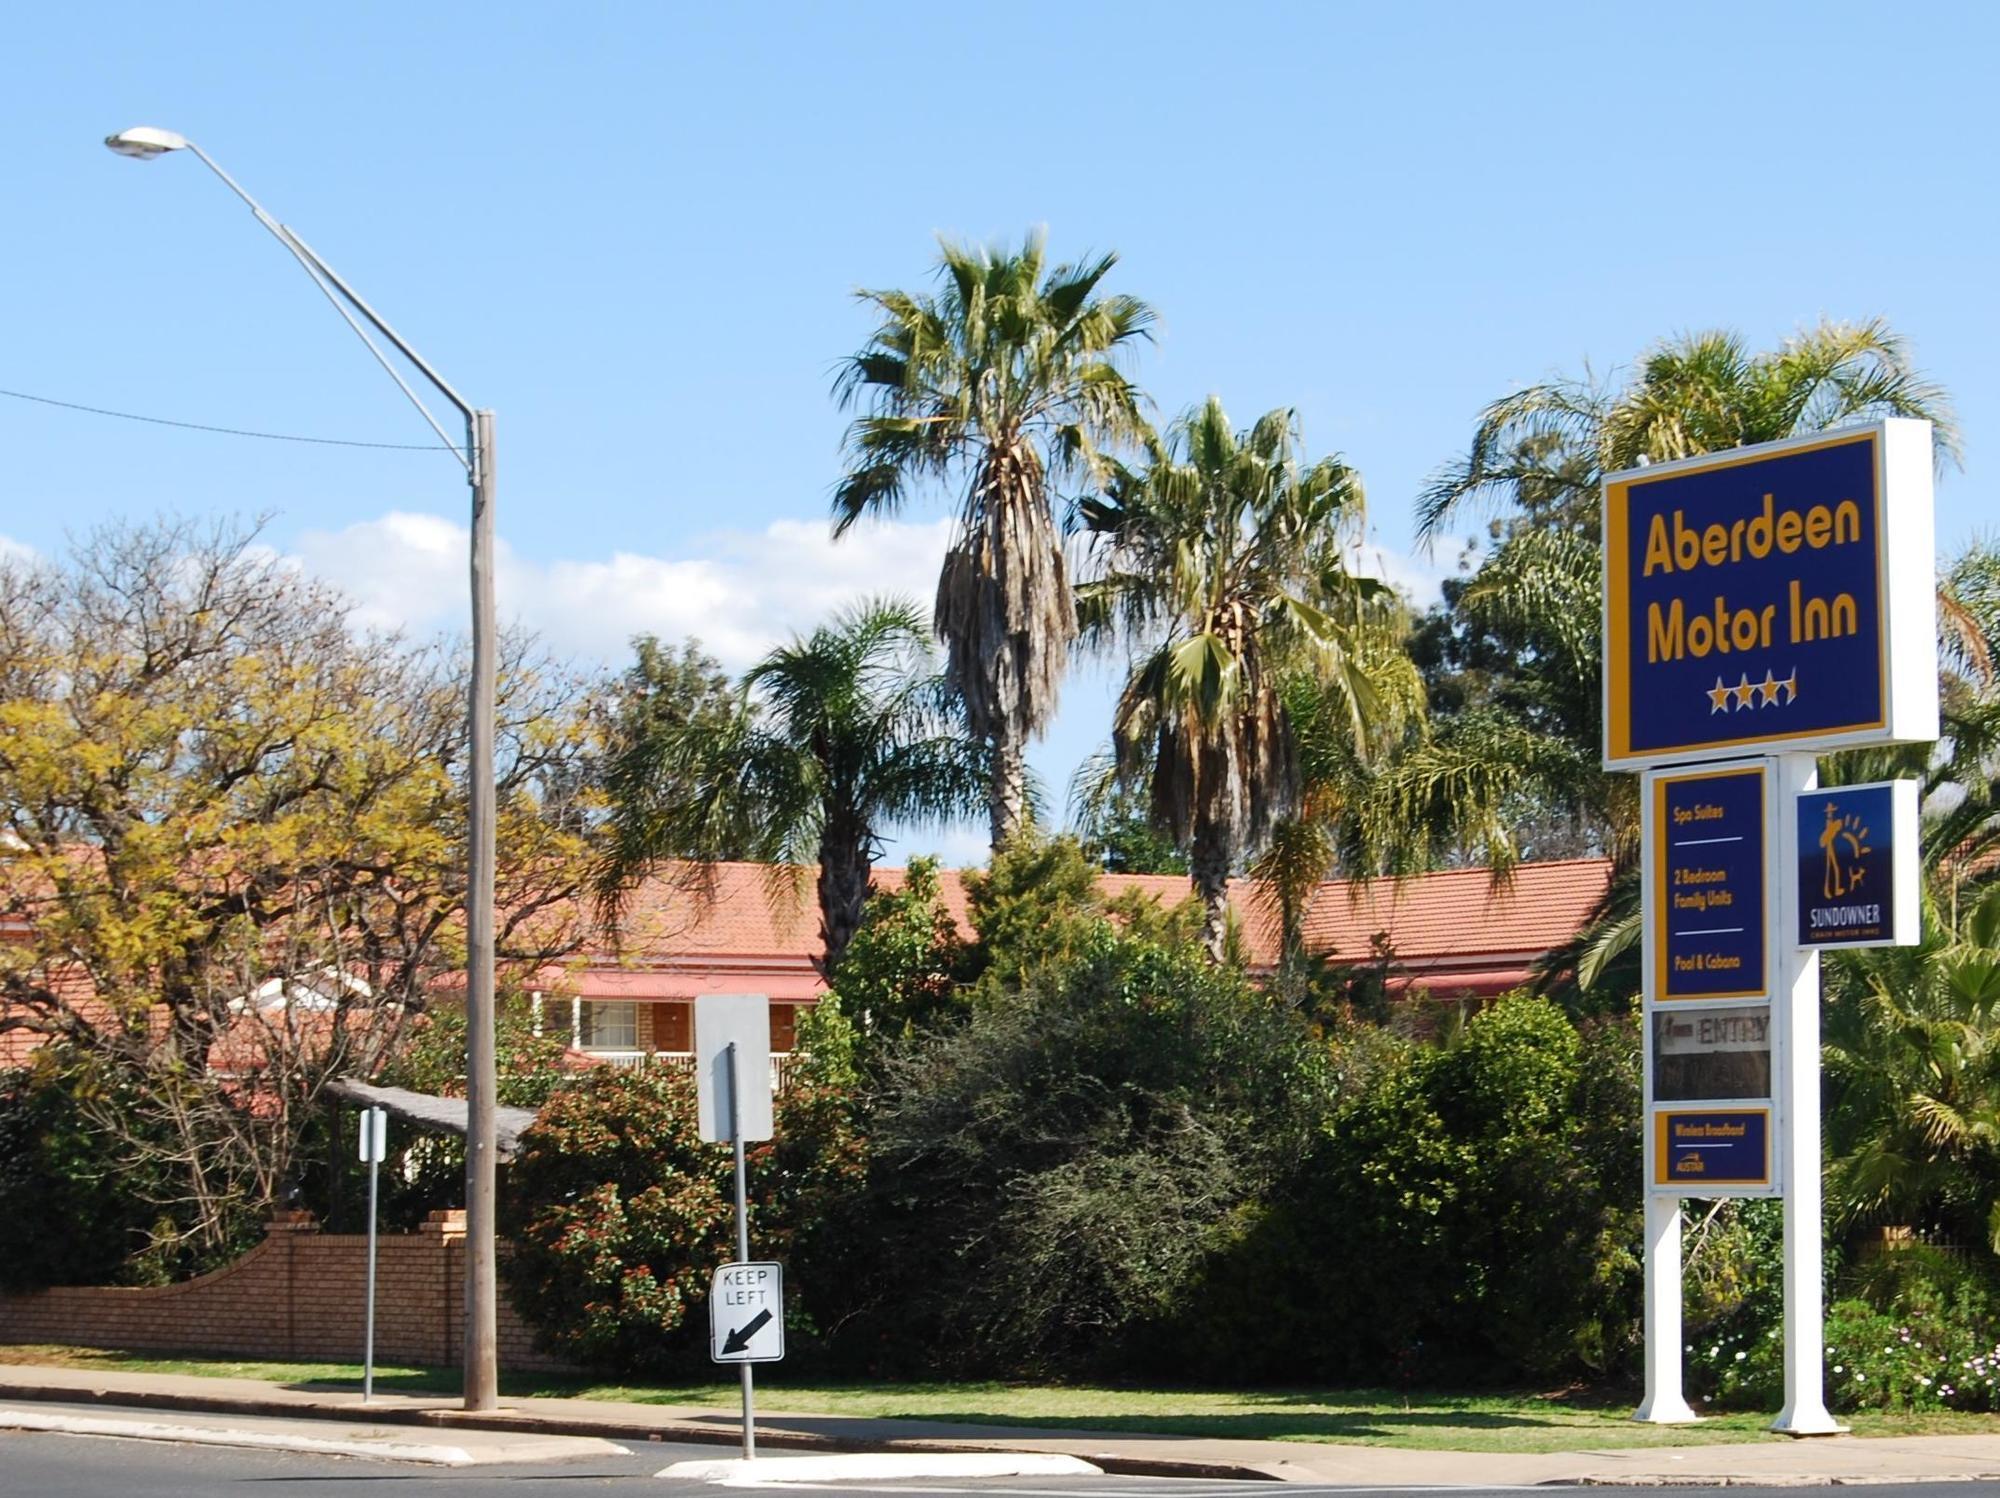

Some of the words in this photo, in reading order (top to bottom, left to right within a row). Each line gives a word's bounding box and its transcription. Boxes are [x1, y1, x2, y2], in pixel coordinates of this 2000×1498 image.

[1643, 493, 1860, 577] Aberdeen
[1648, 597, 1775, 663] Motor
[1789, 580, 1857, 643] Inn
[1673, 806, 1693, 825] Spa
[1695, 804, 1724, 820] Suites
[1674, 869, 1681, 885] 2
[1682, 868, 1727, 884] Bedroom
[1674, 892, 1706, 911] Family
[1707, 890, 1733, 906] Units
[1810, 904, 1880, 928] SUNDOWNER
[1674, 955, 1695, 971] Pool
[1697, 954, 1703, 970] &
[1705, 953, 1741, 969] Cabana
[1697, 1015, 1770, 1044] ENTRY
[723, 1270, 768, 1286] KEEP
[726, 1290, 766, 1305] LEFT
